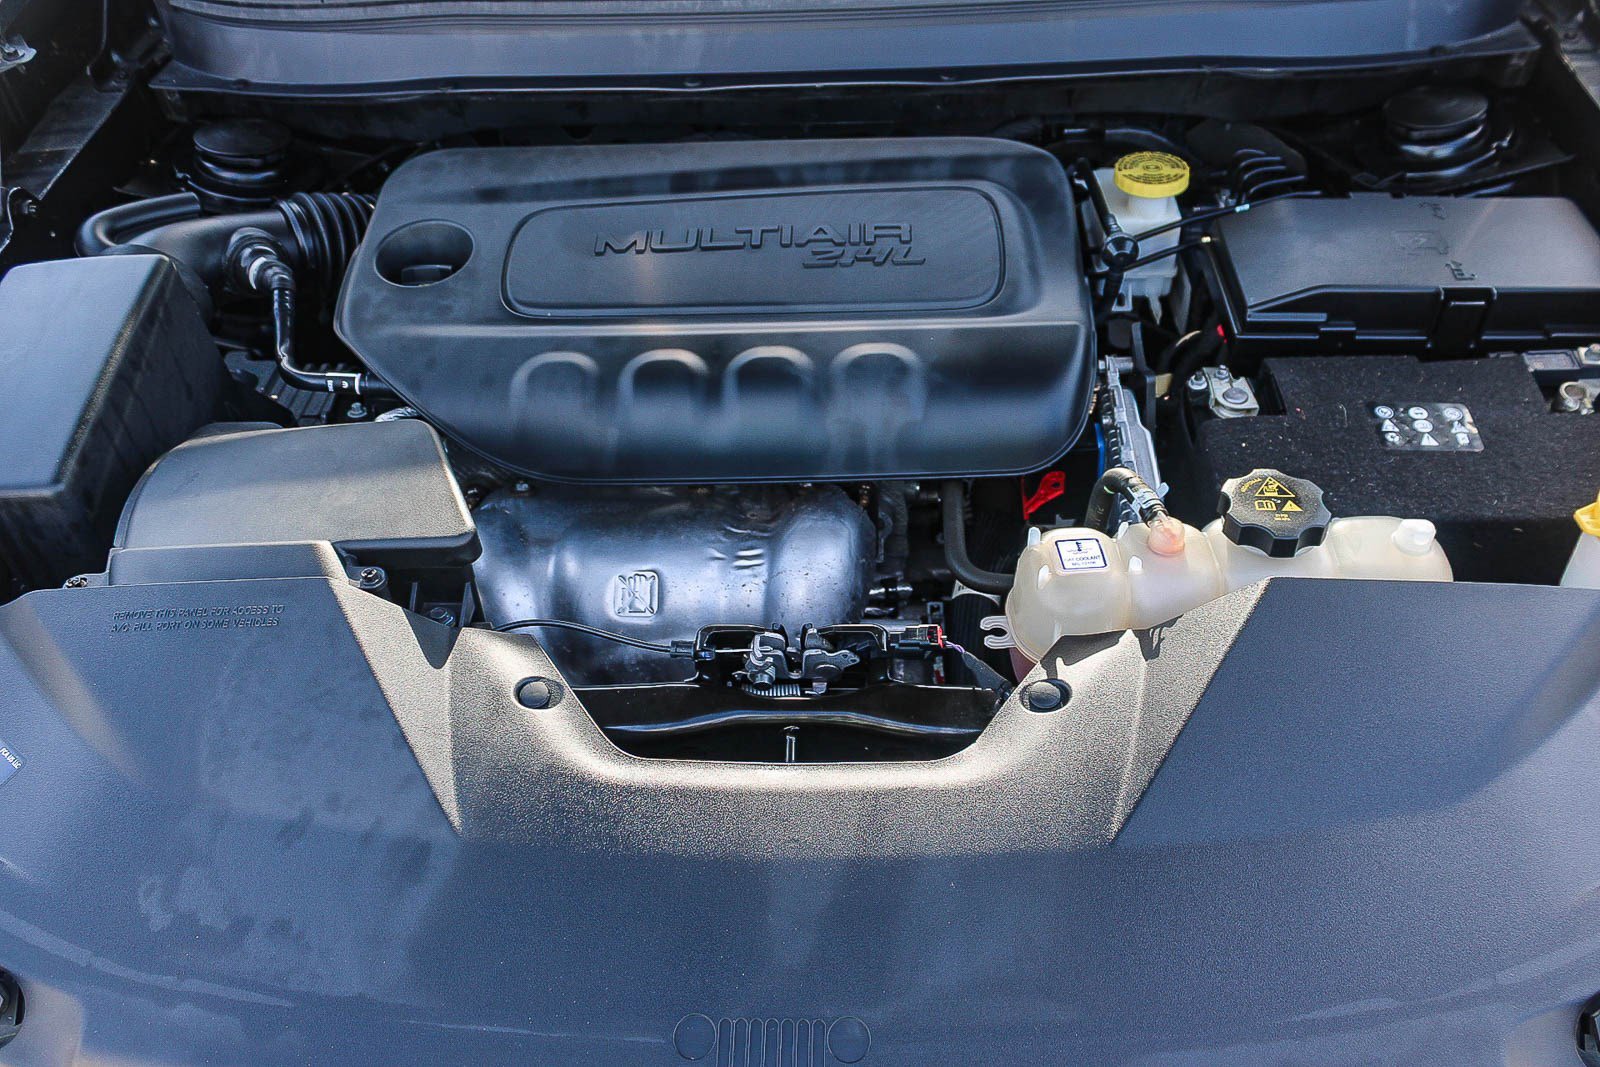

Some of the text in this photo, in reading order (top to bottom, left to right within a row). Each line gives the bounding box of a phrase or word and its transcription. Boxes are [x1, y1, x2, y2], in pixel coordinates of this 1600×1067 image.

[593, 223, 912, 256] MULTIAIR
[801, 245, 927, 268] 2.4L
[1075, 554, 1101, 562] COOLANT
[112, 604, 285, 621] REMOVE THIS PANEL FOR ACCESS TO
[111, 616, 279, 633] A/C FILL PORT ON SOME VEHICLES
